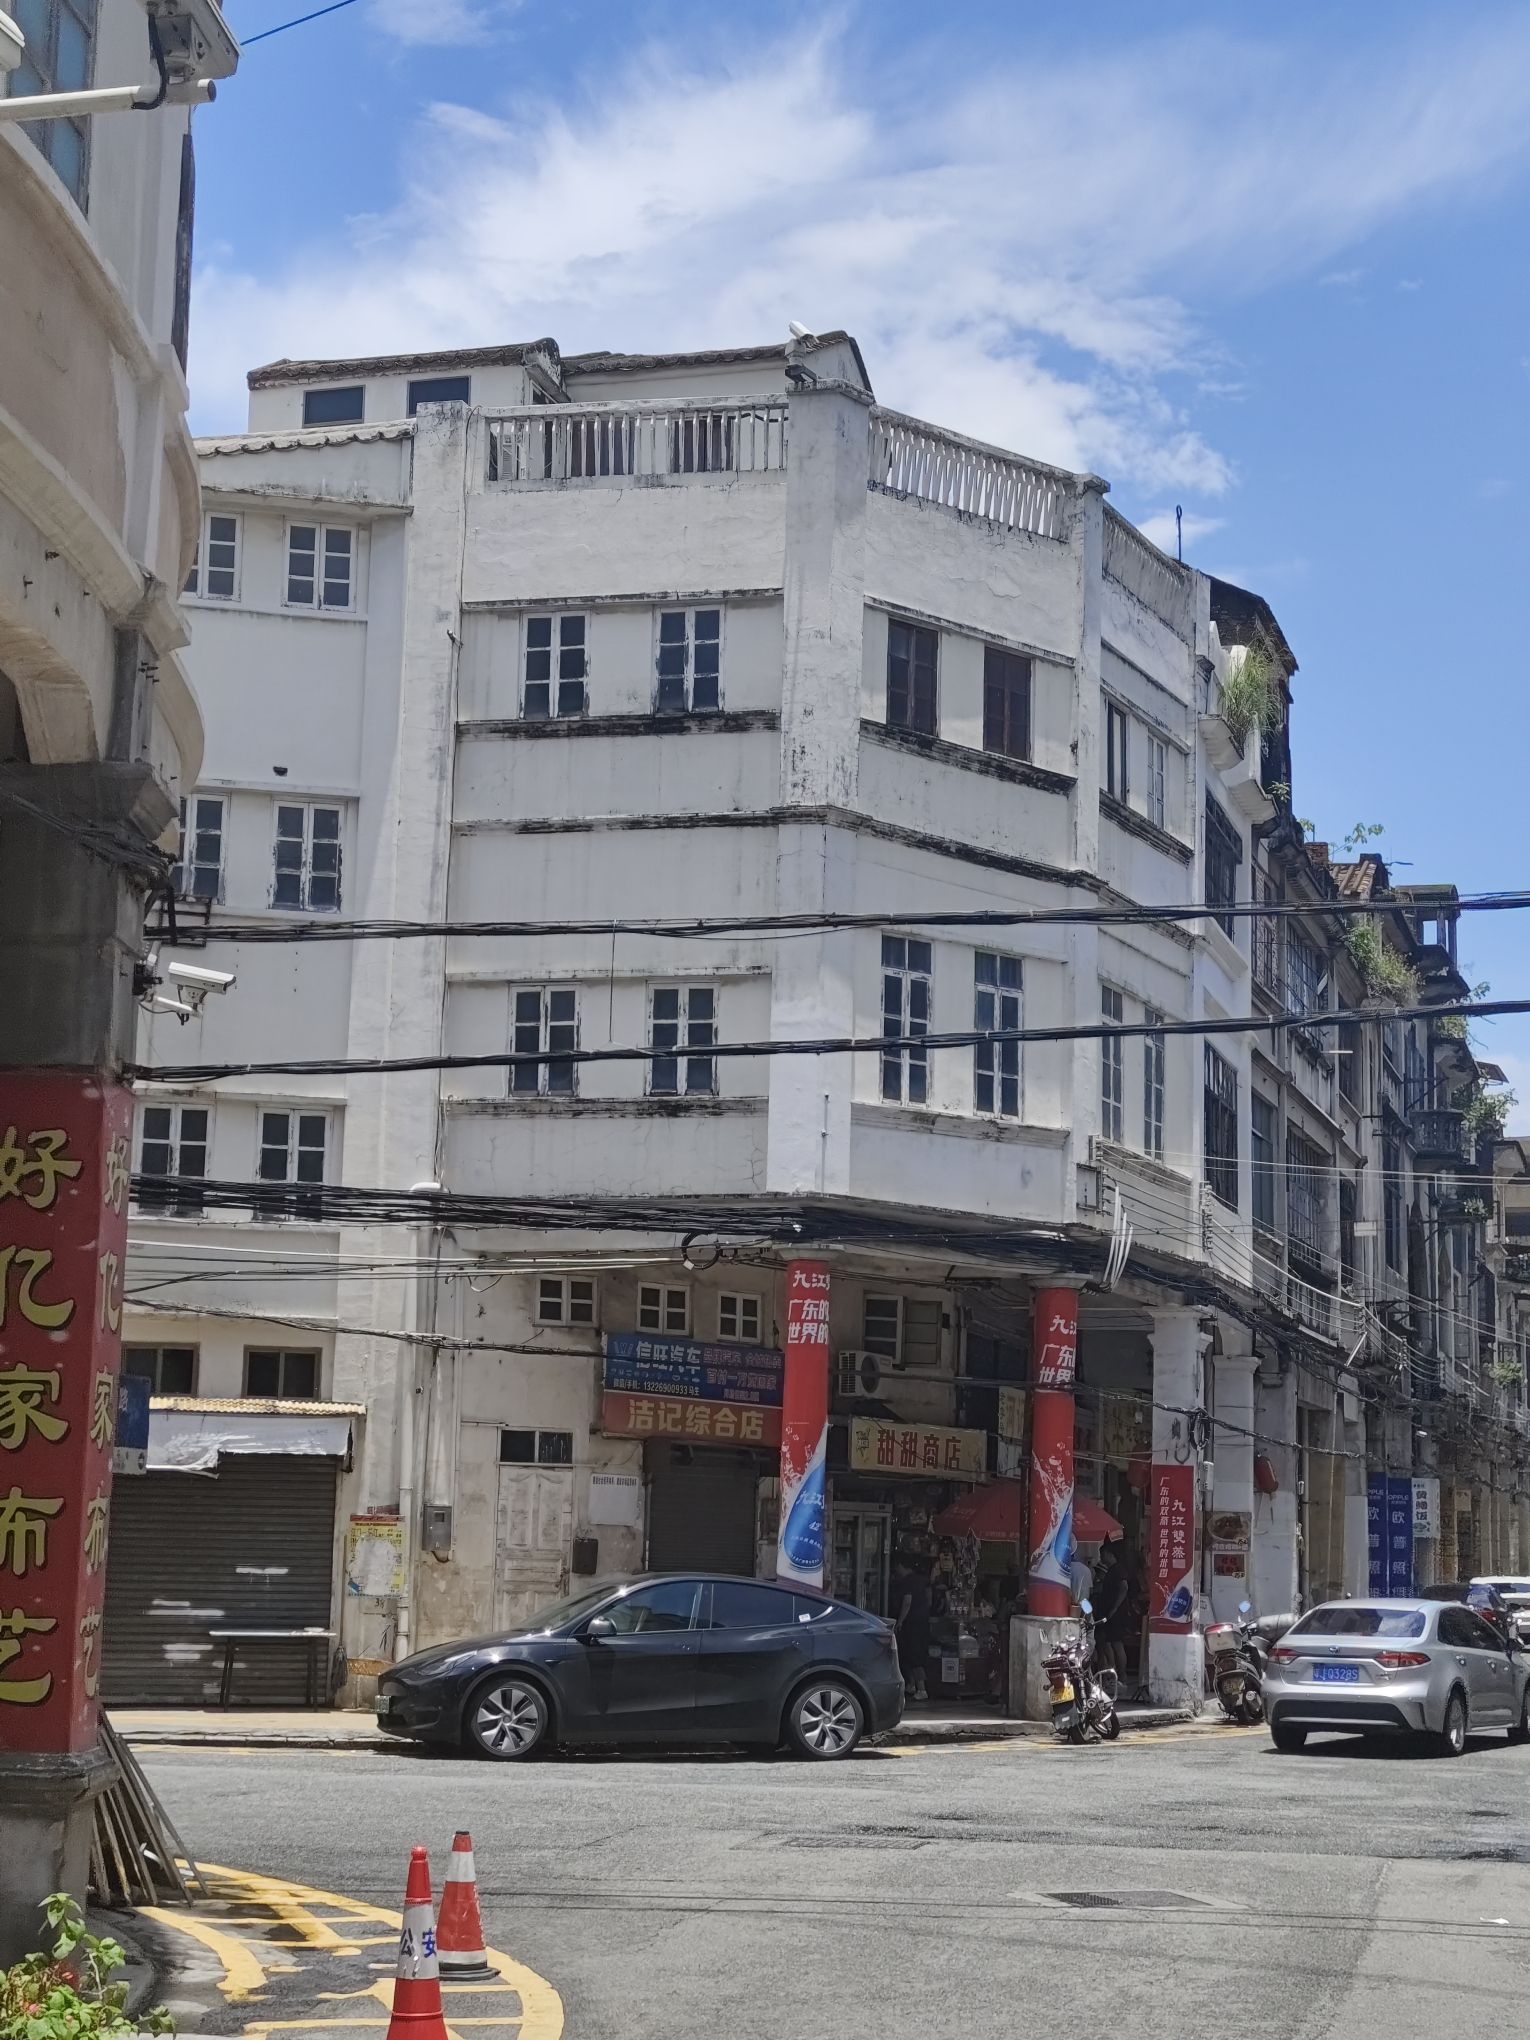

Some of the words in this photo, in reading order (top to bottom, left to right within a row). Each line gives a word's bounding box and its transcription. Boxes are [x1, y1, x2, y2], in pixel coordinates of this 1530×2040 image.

[787, 1298, 830, 1321] 广东的
[787, 1322, 830, 1344] 世界的
[1039, 1343, 1077, 1368] 广东
[1038, 1366, 1076, 1388] 世界
[627, 1399, 764, 1439] 洁记综合店
[876, 1428, 962, 1471] 甜甜商店
[795, 1490, 825, 1509] 九江
